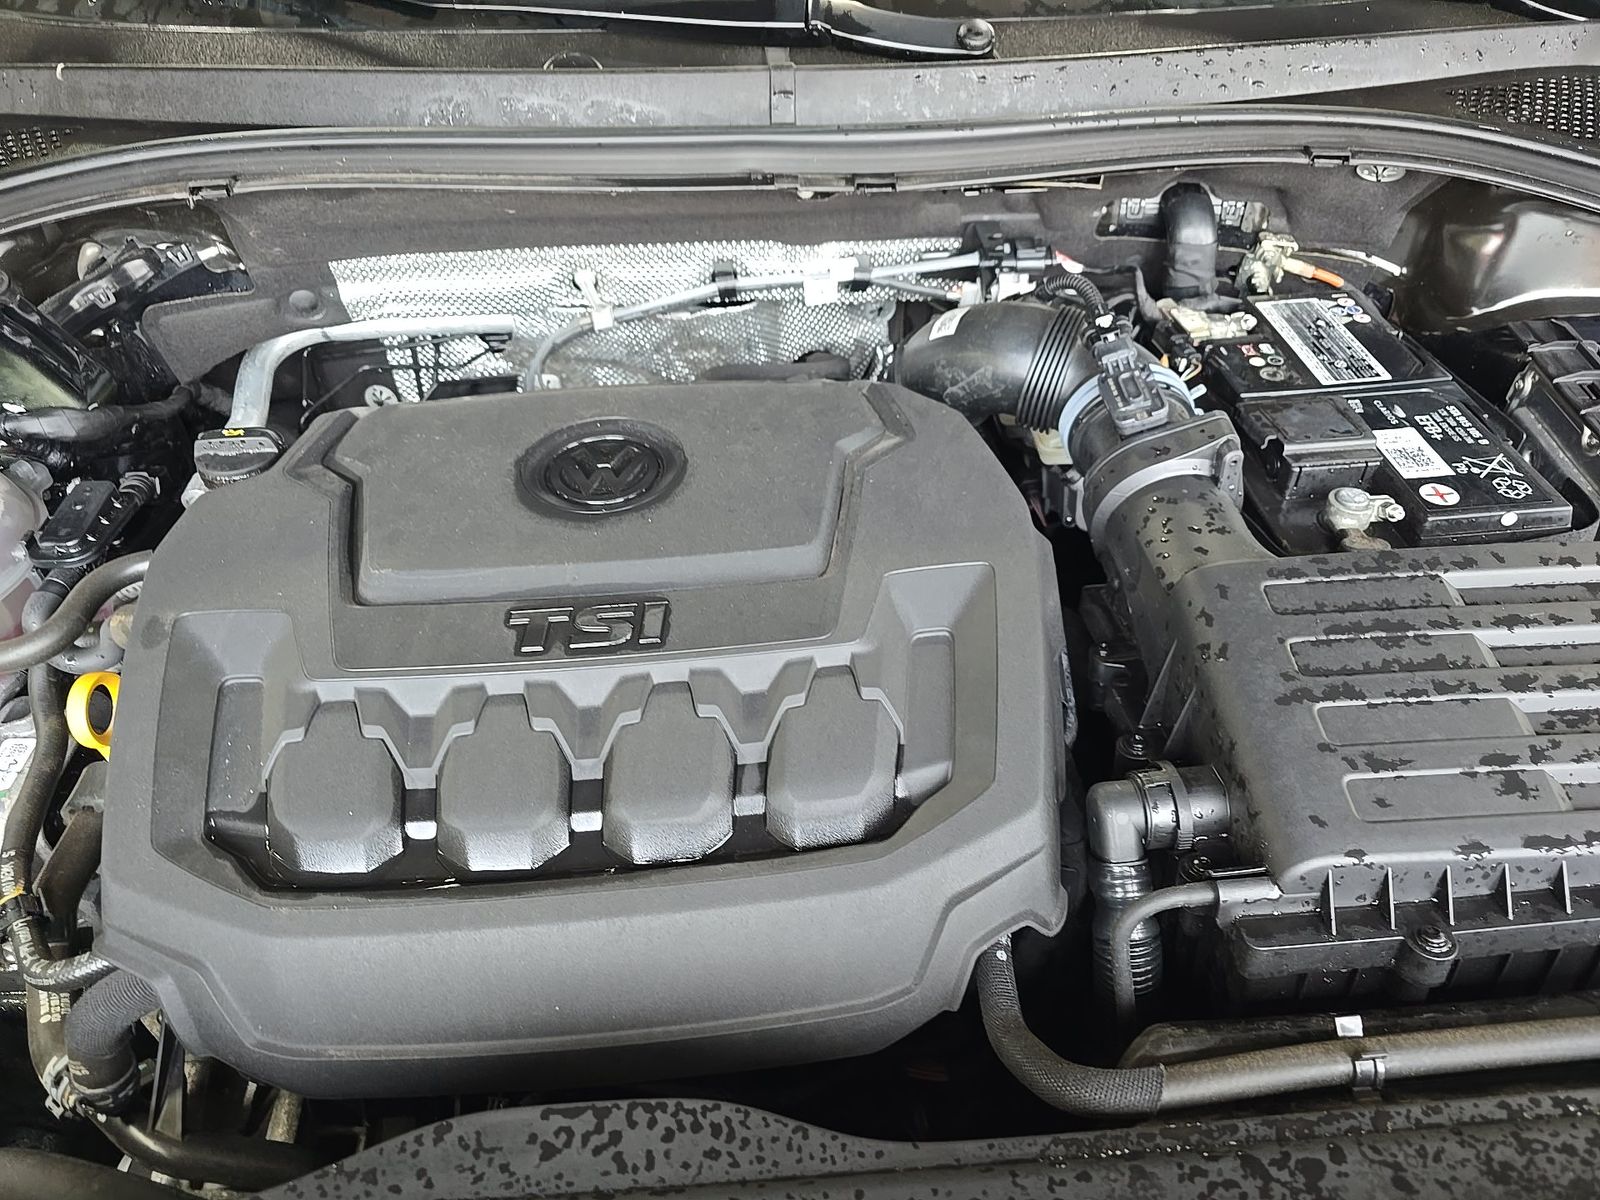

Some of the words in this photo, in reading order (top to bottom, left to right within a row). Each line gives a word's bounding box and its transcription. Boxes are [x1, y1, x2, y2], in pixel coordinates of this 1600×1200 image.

[1413, 415, 1444, 441] EFB+
[1451, 461, 1469, 474] Pb
[508, 600, 669, 653] TSI
